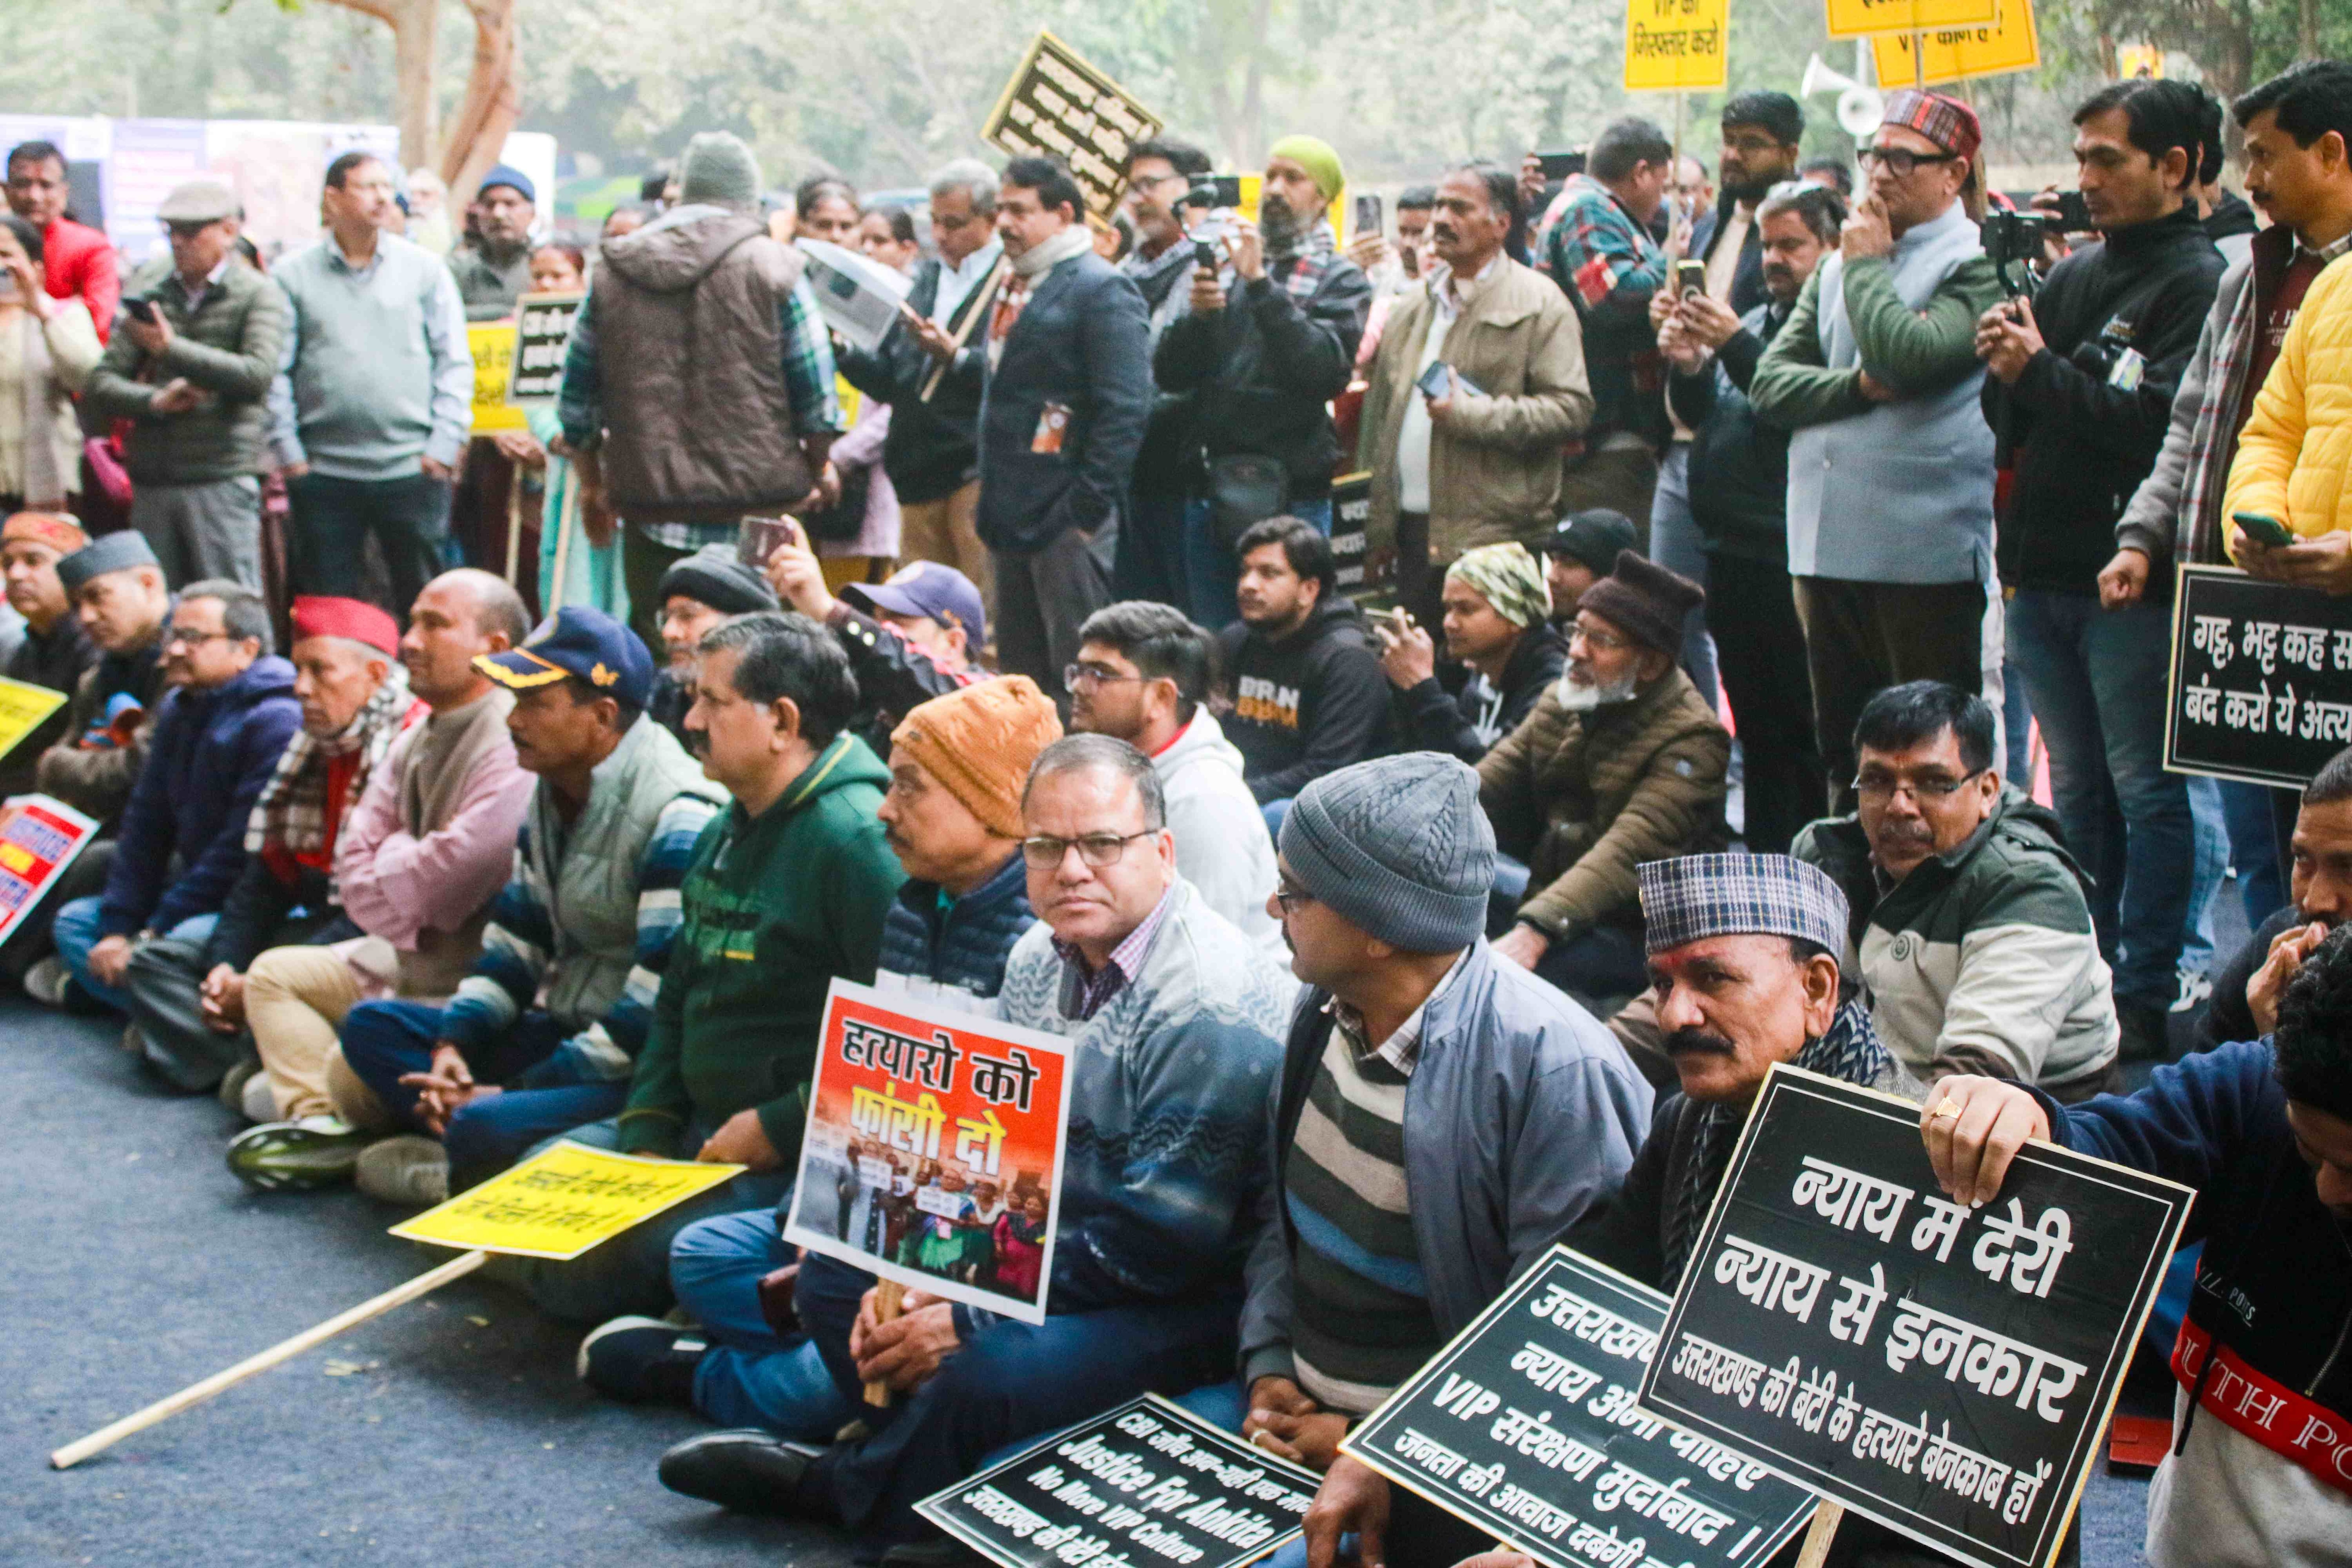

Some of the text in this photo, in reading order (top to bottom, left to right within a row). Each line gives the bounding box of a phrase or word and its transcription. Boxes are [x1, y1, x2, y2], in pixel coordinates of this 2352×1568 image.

[2283, 625, 2328, 671] कह
[2185, 673, 2221, 726] बंद
[2225, 679, 2272, 732] करो
[2275, 683, 2297, 735] ये
[970, 1048, 1040, 1113] को
[954, 1108, 1008, 1177] दो
[1793, 1155, 1915, 1243] न्याय
[1972, 1197, 2074, 1298] देरी
[1510, 1340, 1603, 1403] न्याय
[1714, 1234, 2088, 1423] न्याय से इनकार
[1672, 1331, 2052, 1525] उत्तराखण्ड की बेटी के हत्यारे बेनकाब हों
[2174, 1336, 2288, 1431] UTH
[1057, 1434, 1275, 1549] Justice For Ankita
[1116, 1413, 1163, 1439] CBI
[1245, 1479, 1290, 1501] एक
[1394, 1426, 1646, 1568] जनता की आवाज दबेगी
[1432, 1372, 1501, 1421] VIP
[1490, 1406, 1609, 1482] संरक्षण
[1592, 1460, 1736, 1546] मुर्दाबाद
[1027, 1465, 1065, 1490] No
[1052, 1480, 1108, 1515] More
[1097, 1503, 1147, 1530] VIP
[1129, 1521, 1204, 1564] Culture
[1032, 1525, 1082, 1550] की
[1056, 1535, 1110, 1566] बेटी
